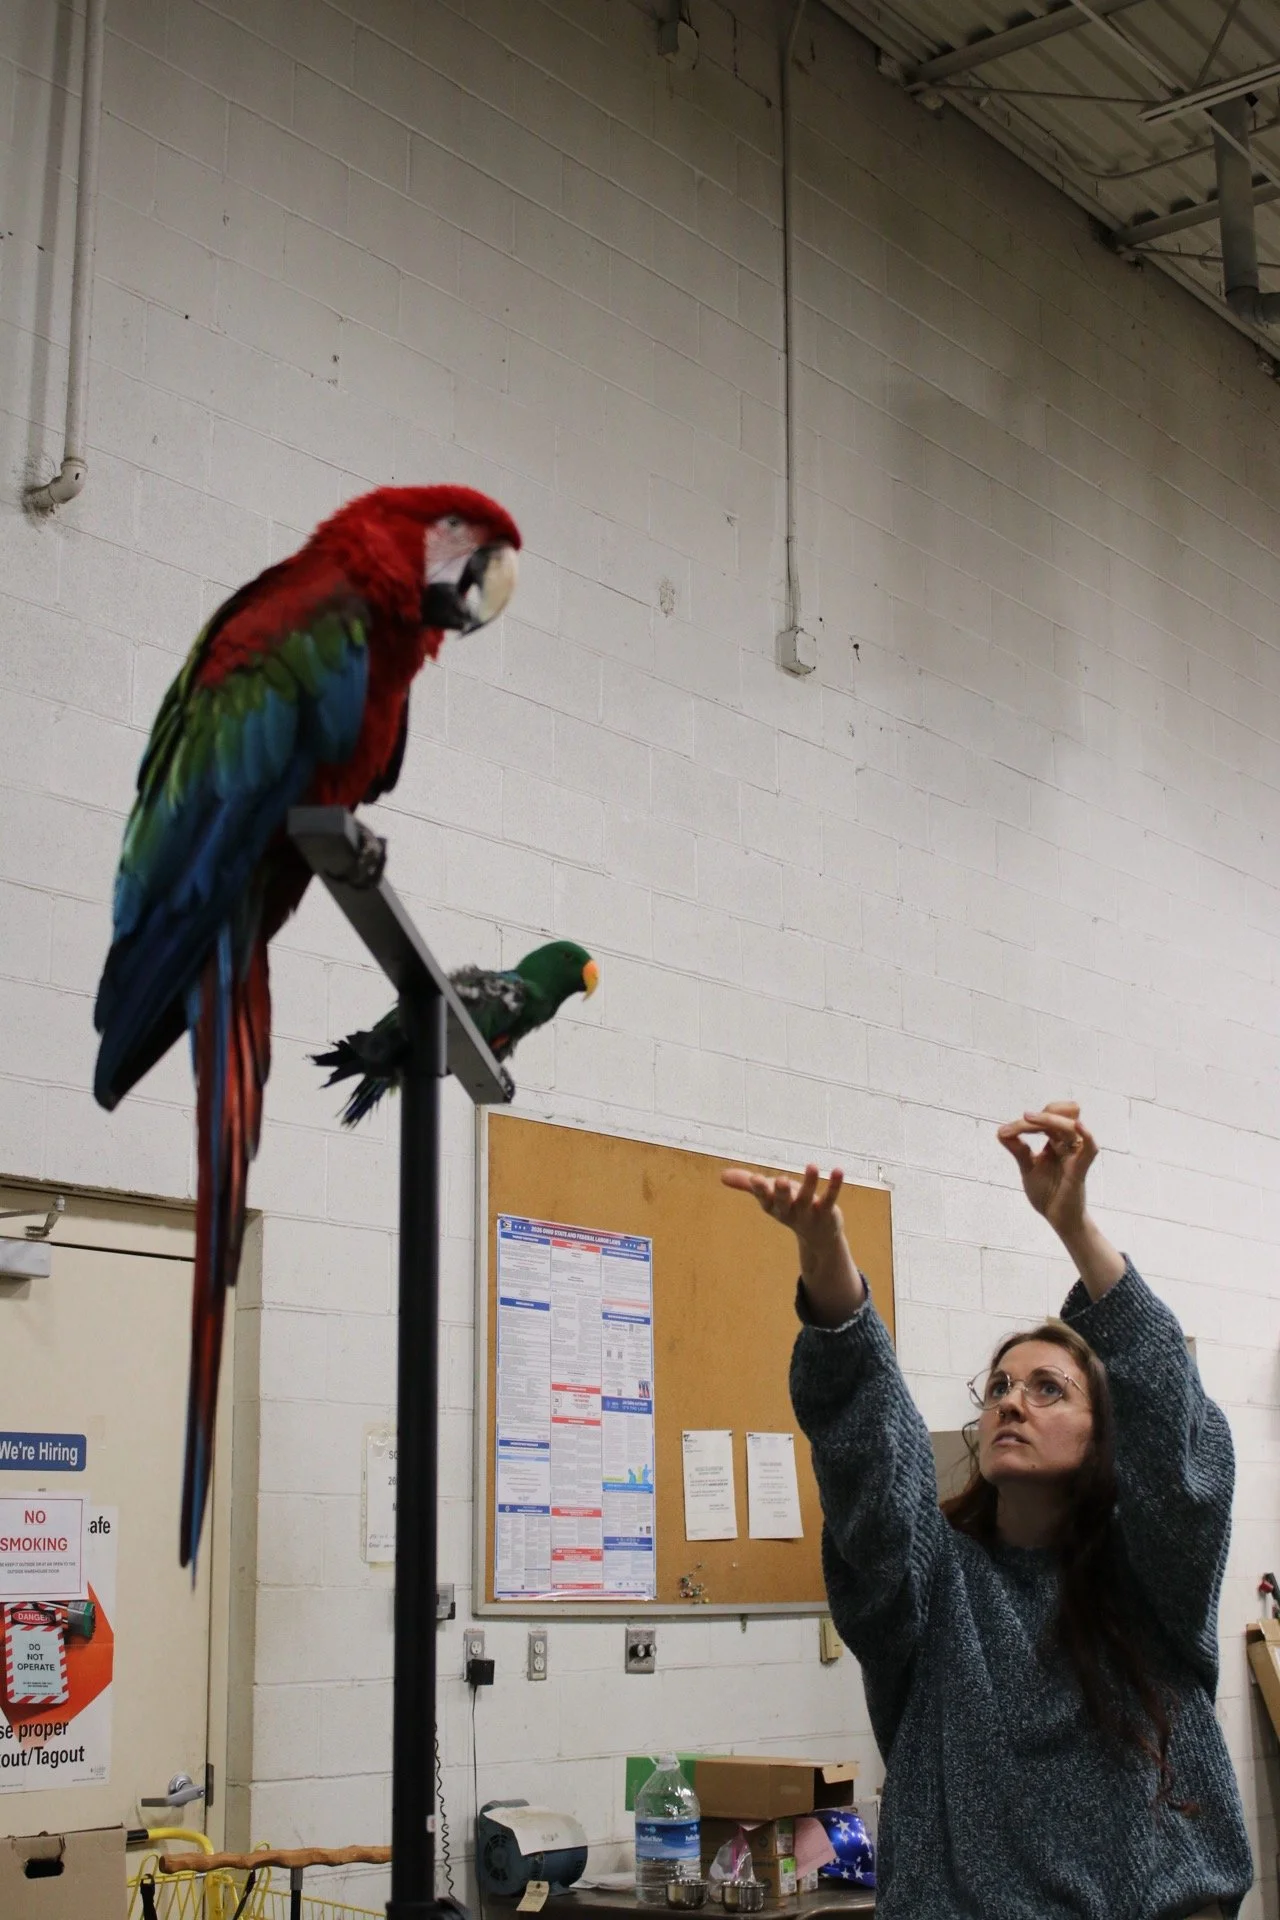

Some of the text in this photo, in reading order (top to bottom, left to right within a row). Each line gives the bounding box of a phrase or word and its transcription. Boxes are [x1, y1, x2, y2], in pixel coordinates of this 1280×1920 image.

[577, 1232, 595, 1241] FEDERAL
[0, 1441, 78, 1466] We're Hiring
[24, 1510, 47, 1524] NO
[87, 1516, 111, 1534] afe
[0, 1537, 68, 1551] SMOKING
[29, 1643, 41, 1651] DO
[17, 1663, 55, 1671] OPERATE
[19, 1721, 69, 1742] proper
[0, 1746, 85, 1769] out/Tagout
